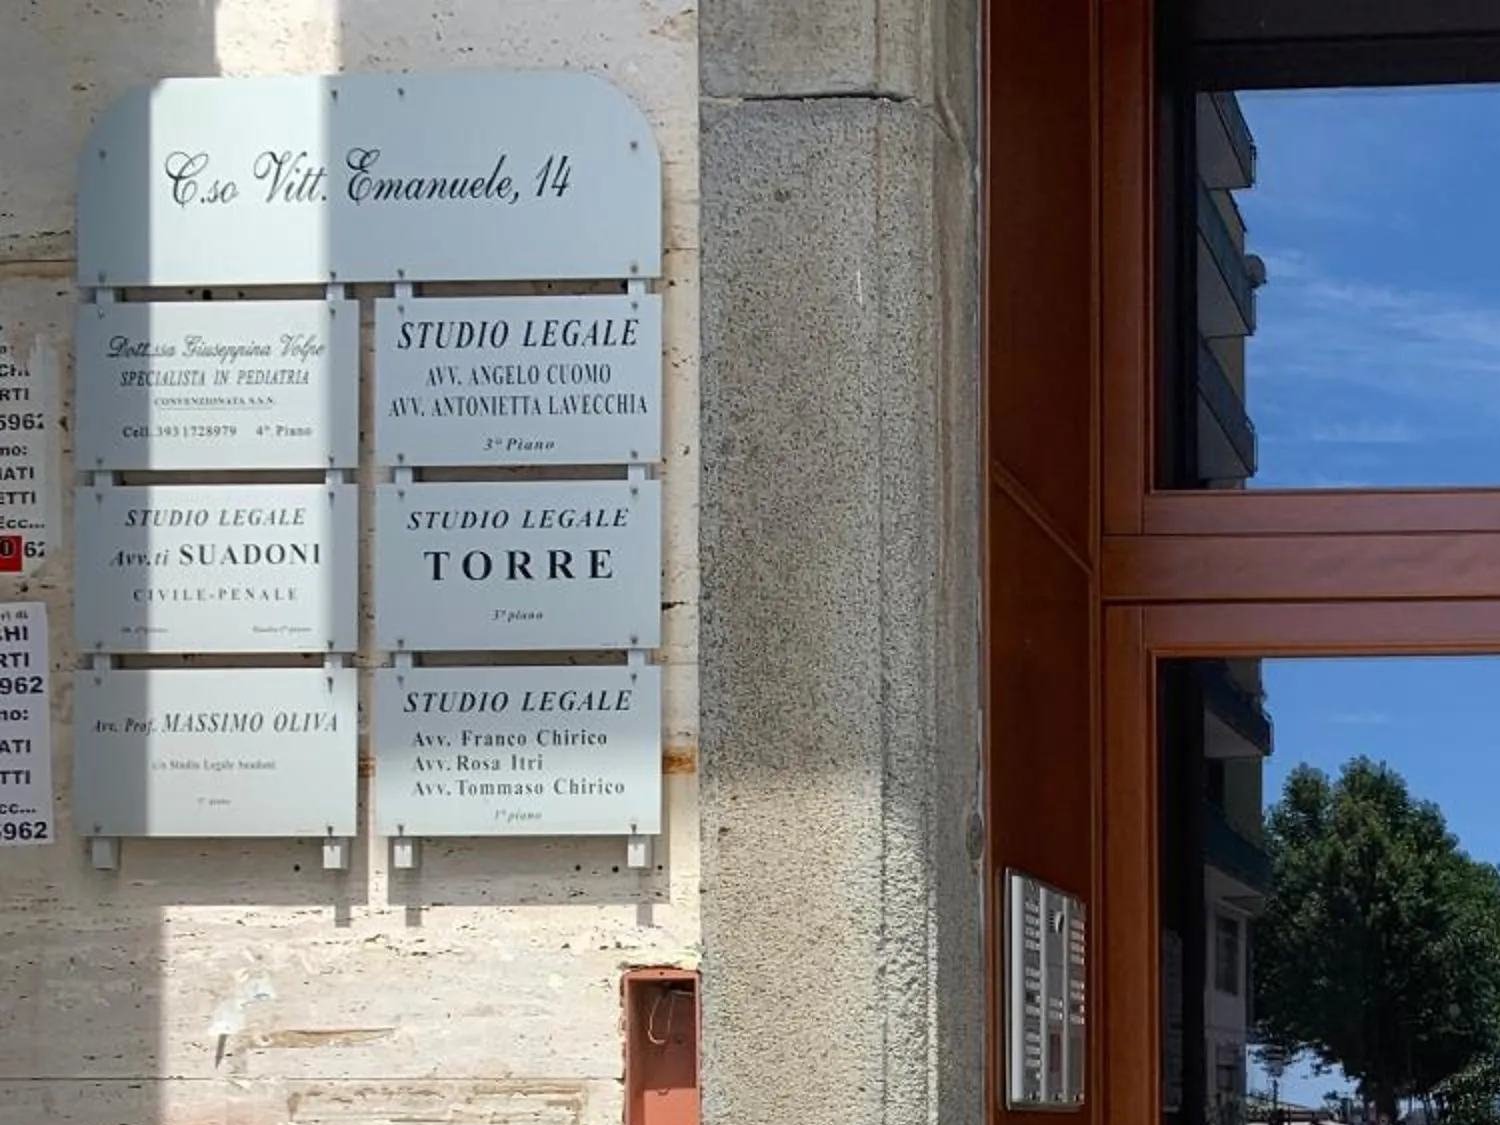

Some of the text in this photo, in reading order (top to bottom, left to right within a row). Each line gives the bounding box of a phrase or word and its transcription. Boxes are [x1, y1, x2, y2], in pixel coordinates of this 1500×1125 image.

[164, 147, 571, 205] C.so Vitt. Emanuele, 14
[397, 319, 640, 349] STUDIO LEGALE
[120, 368, 309, 386] SPECIALISTA IN PEDIATRIA
[426, 363, 611, 386] AVV. ANGELO CUOMO
[388, 393, 648, 417] AVV. ANTONIETTA LAVECCHIA
[506, 438, 555, 450] Piano
[125, 508, 306, 527] STUDIO LEGALE
[407, 508, 629, 530] STUDIO LEGALE
[179, 543, 320, 565] SUADONI
[424, 549, 613, 581] TORRE
[403, 689, 632, 713] STUDIO LEGALE
[161, 711, 264, 734] MASSIMO
[272, 711, 338, 733] OLIVA
[413, 729, 608, 748] Avv. Franco Chirico
[413, 754, 543, 772] Avv. Rosa Itri
[413, 778, 625, 797] Avv. Tommaso Chirico
